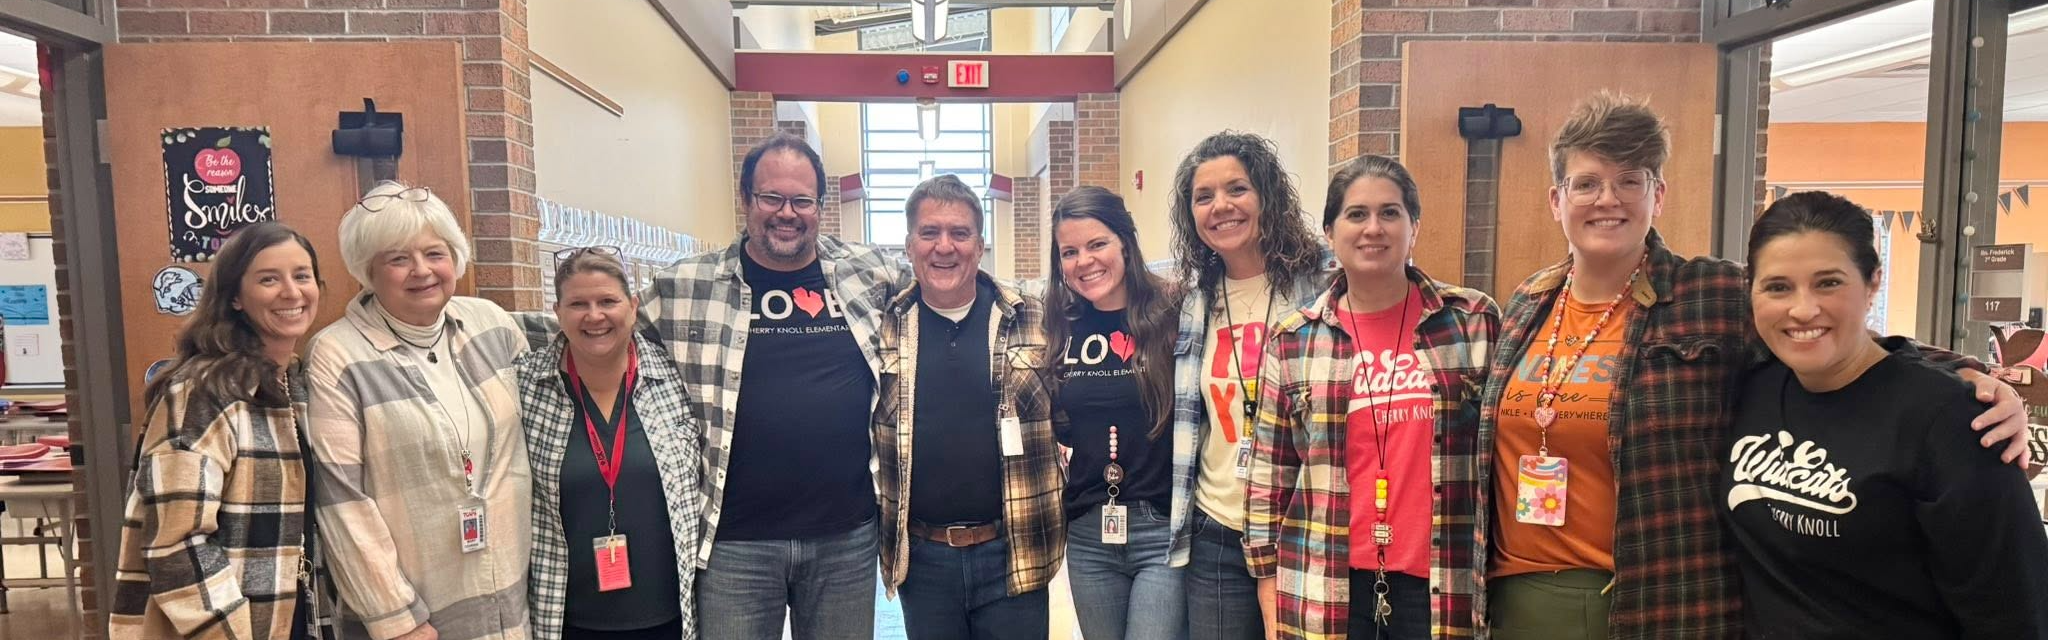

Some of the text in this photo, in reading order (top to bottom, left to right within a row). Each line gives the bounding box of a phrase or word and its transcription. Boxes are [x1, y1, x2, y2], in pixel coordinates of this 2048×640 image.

[956, 63, 982, 85] EXIT
[204, 153, 235, 167] Be the
[206, 168, 235, 178] reason
[204, 184, 237, 194] SOMEONE
[183, 173, 271, 230] Smiles
[201, 235, 221, 251] TO
[1985, 301, 2001, 312] 117
[748, 326, 775, 334] HERRY
[777, 326, 803, 334] KNOLL
[1349, 349, 1432, 395] ildca
[1506, 387, 1533, 402] is
[1373, 404, 1434, 424] CHERRY KNO
[1500, 408, 1521, 417] NKLE
[1556, 411, 1609, 421] ERYWHERE
[1797, 514, 1840, 538] KNOLL
